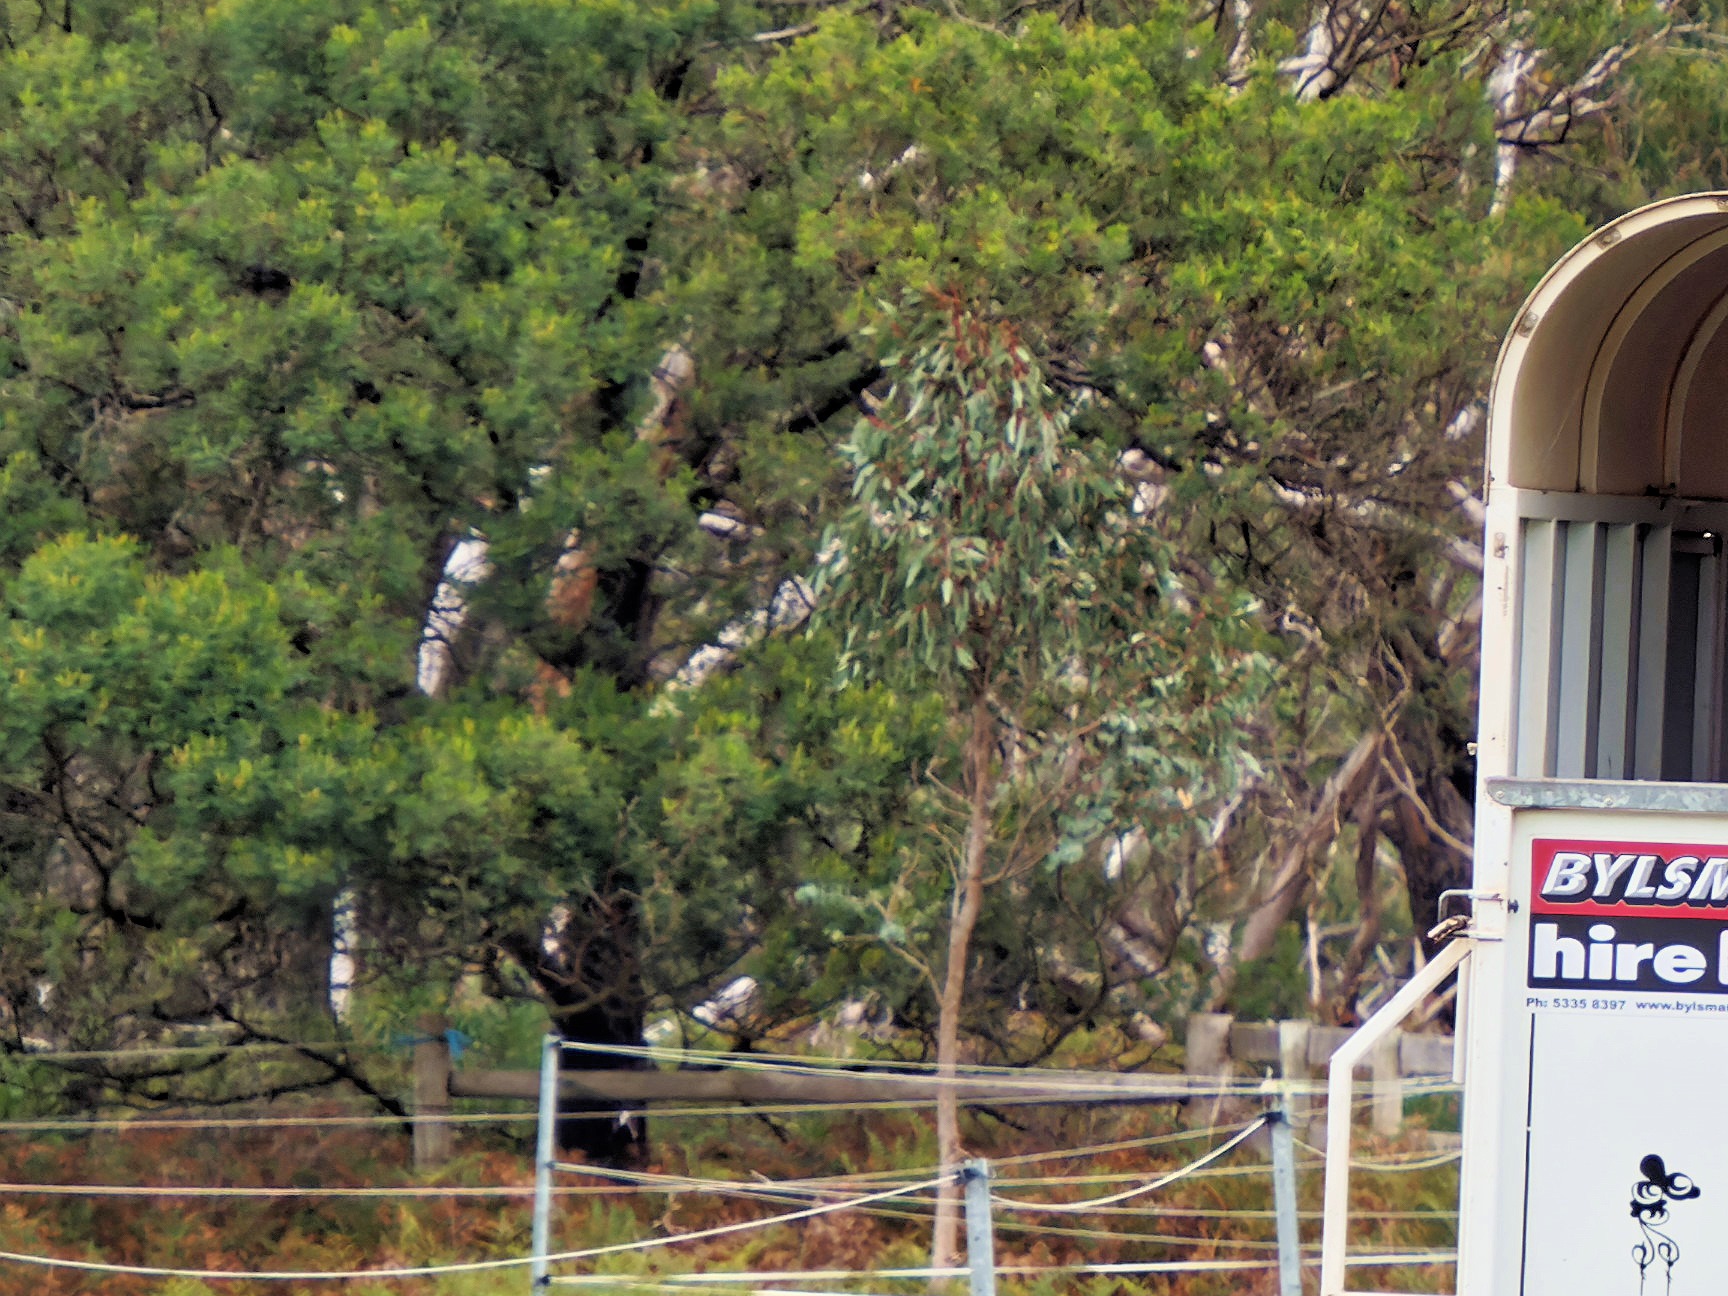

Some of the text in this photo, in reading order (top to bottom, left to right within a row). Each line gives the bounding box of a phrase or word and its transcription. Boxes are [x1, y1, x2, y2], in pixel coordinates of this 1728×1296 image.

[1532, 923, 1707, 983] hire
[1526, 997, 1549, 1010] Ph:
[1553, 998, 1588, 1010] 5335
[1592, 999, 1627, 1010] 8397
